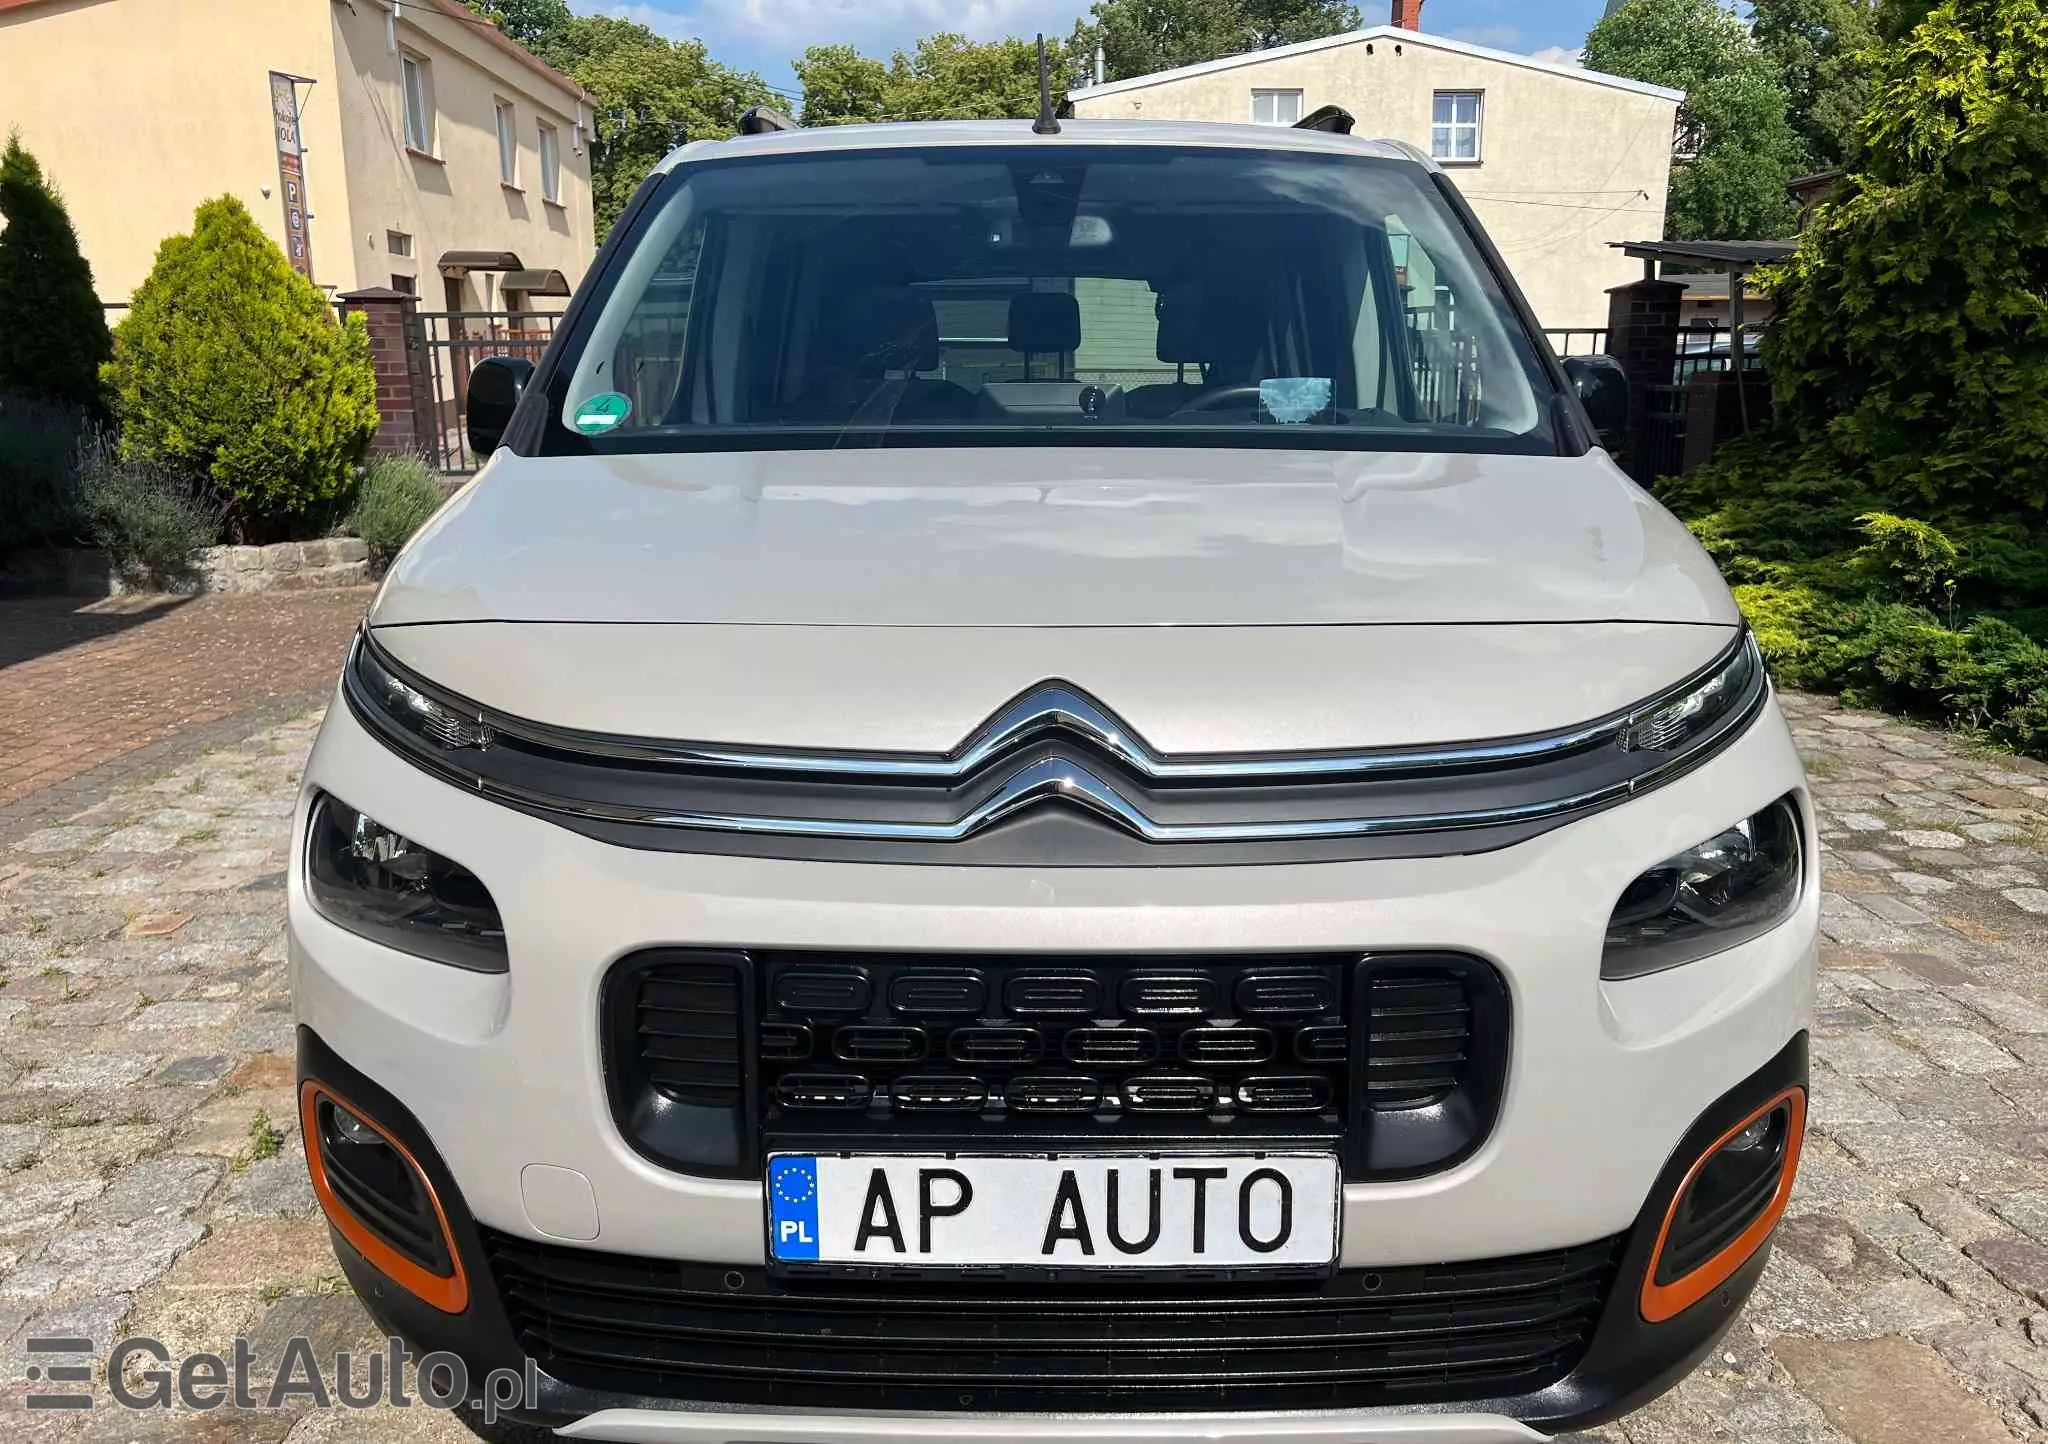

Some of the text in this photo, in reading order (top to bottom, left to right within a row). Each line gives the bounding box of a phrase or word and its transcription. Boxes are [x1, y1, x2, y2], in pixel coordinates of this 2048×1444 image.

[780, 1220, 813, 1244] PL
[853, 1167, 1293, 1256] AP AUTO
